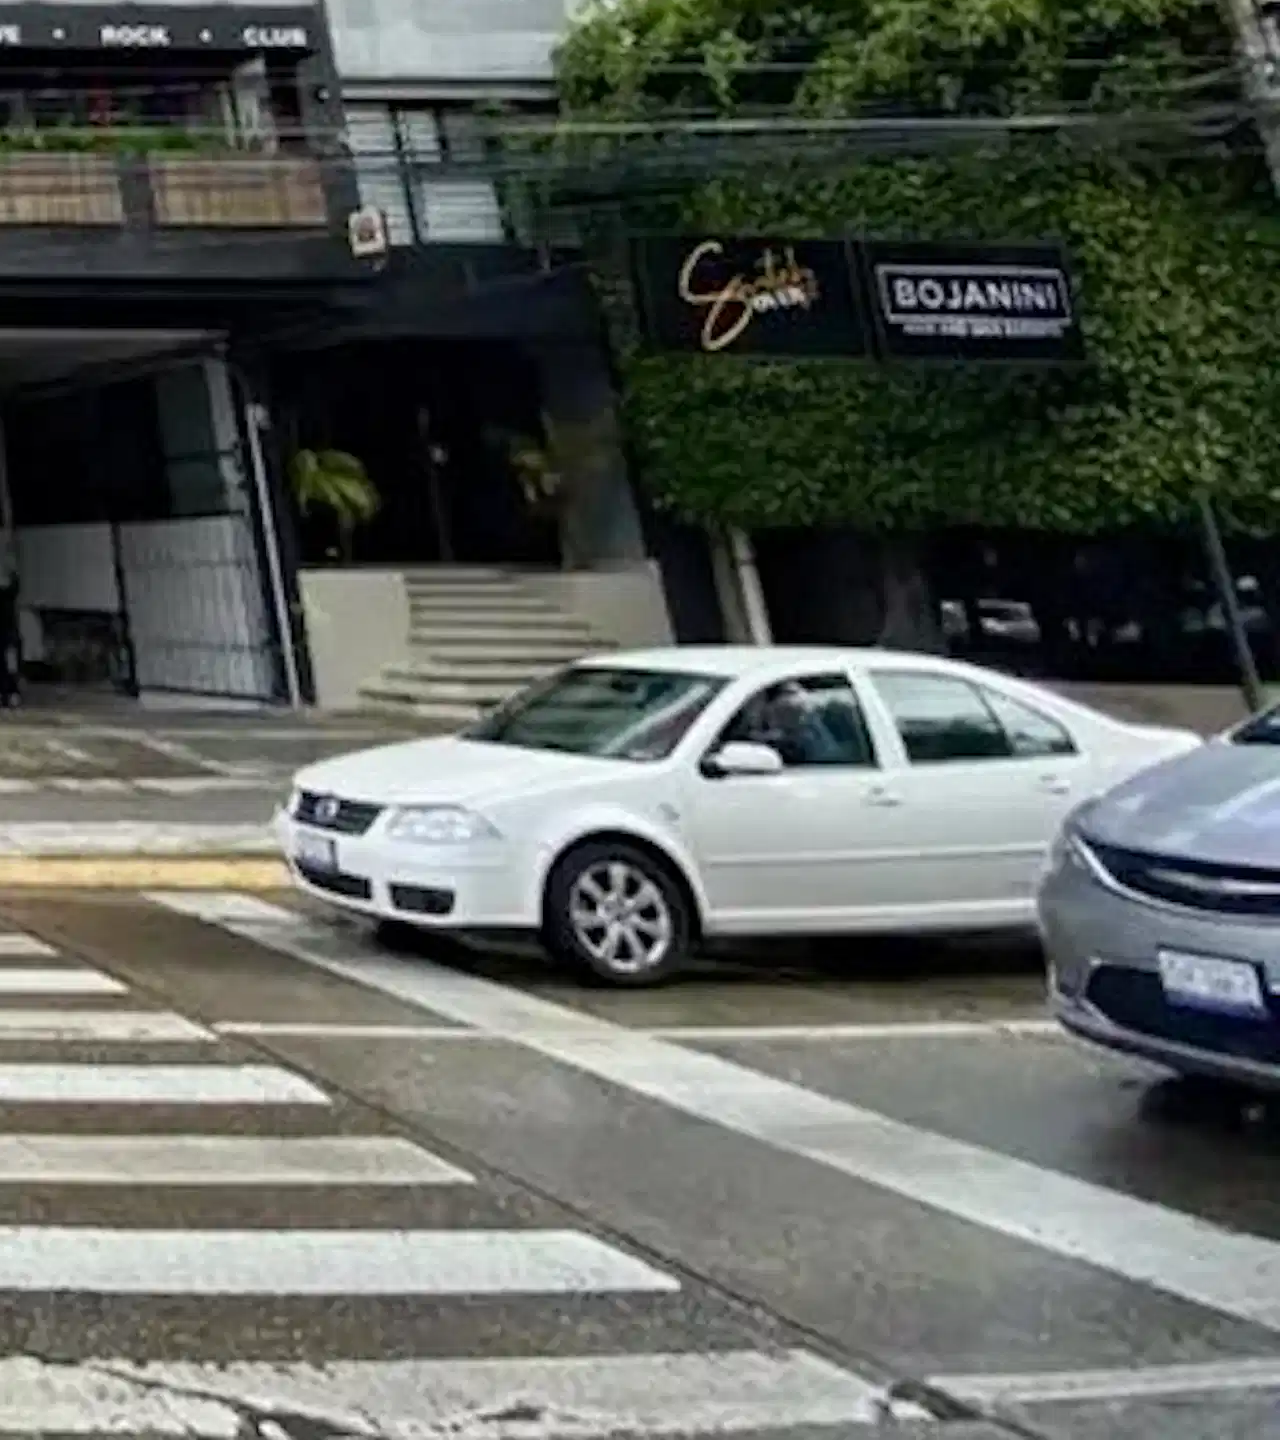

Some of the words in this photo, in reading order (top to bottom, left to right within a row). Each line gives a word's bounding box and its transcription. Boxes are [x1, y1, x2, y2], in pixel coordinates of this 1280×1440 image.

[100, 25, 170, 45] ROCK
[241, 27, 307, 46] CLUB
[892, 278, 1057, 310] BOJANINI
